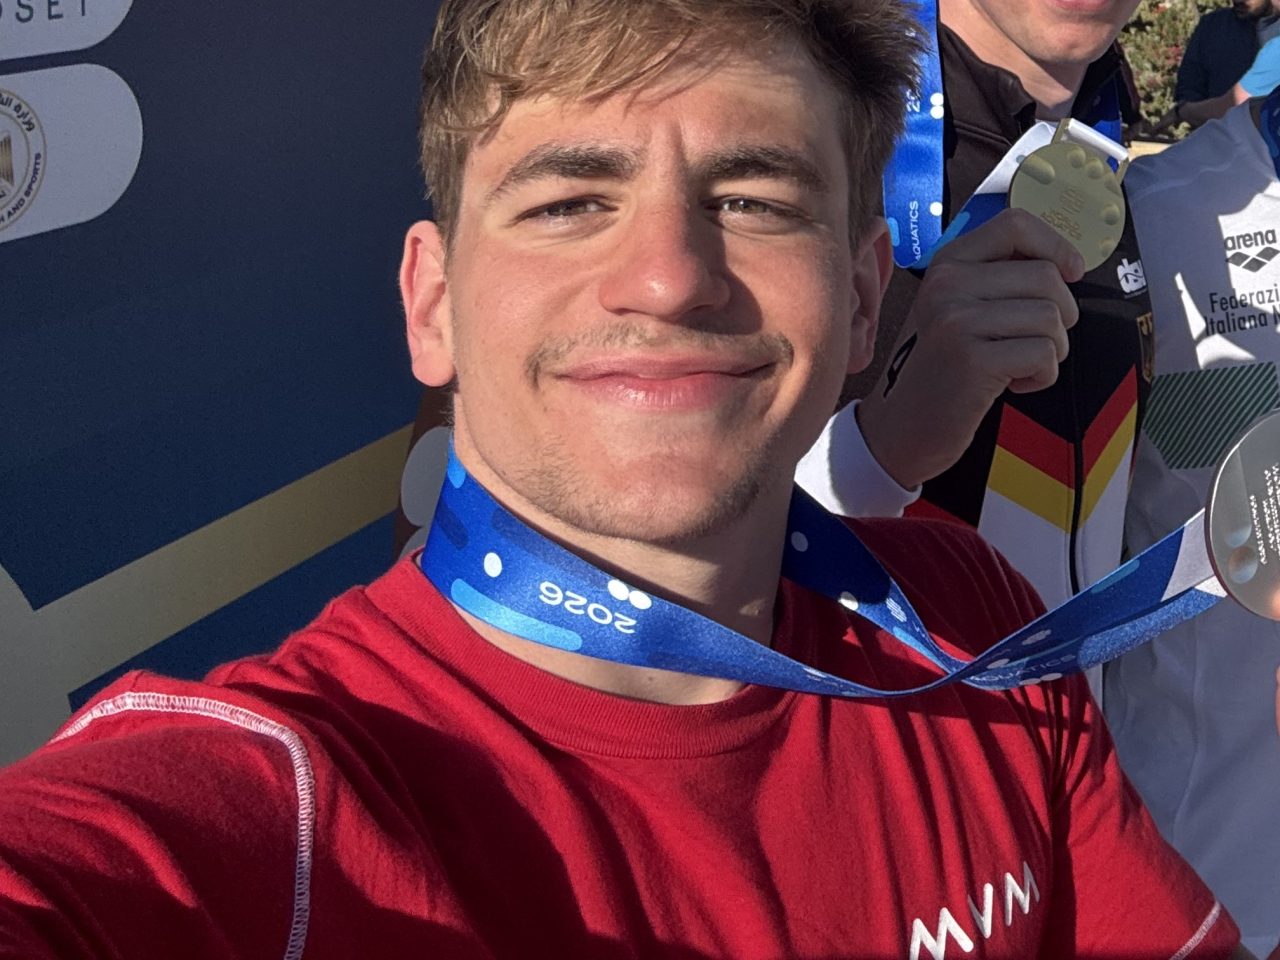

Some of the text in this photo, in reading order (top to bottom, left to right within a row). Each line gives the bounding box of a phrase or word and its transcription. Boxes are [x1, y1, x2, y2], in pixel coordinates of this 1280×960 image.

[7, 152, 41, 219] AND SPORTS
[1224, 229, 1277, 251] arena
[1205, 311, 1268, 337] Italiana
[539, 581, 637, 634] 2026
[909, 860, 1040, 960] MVM
